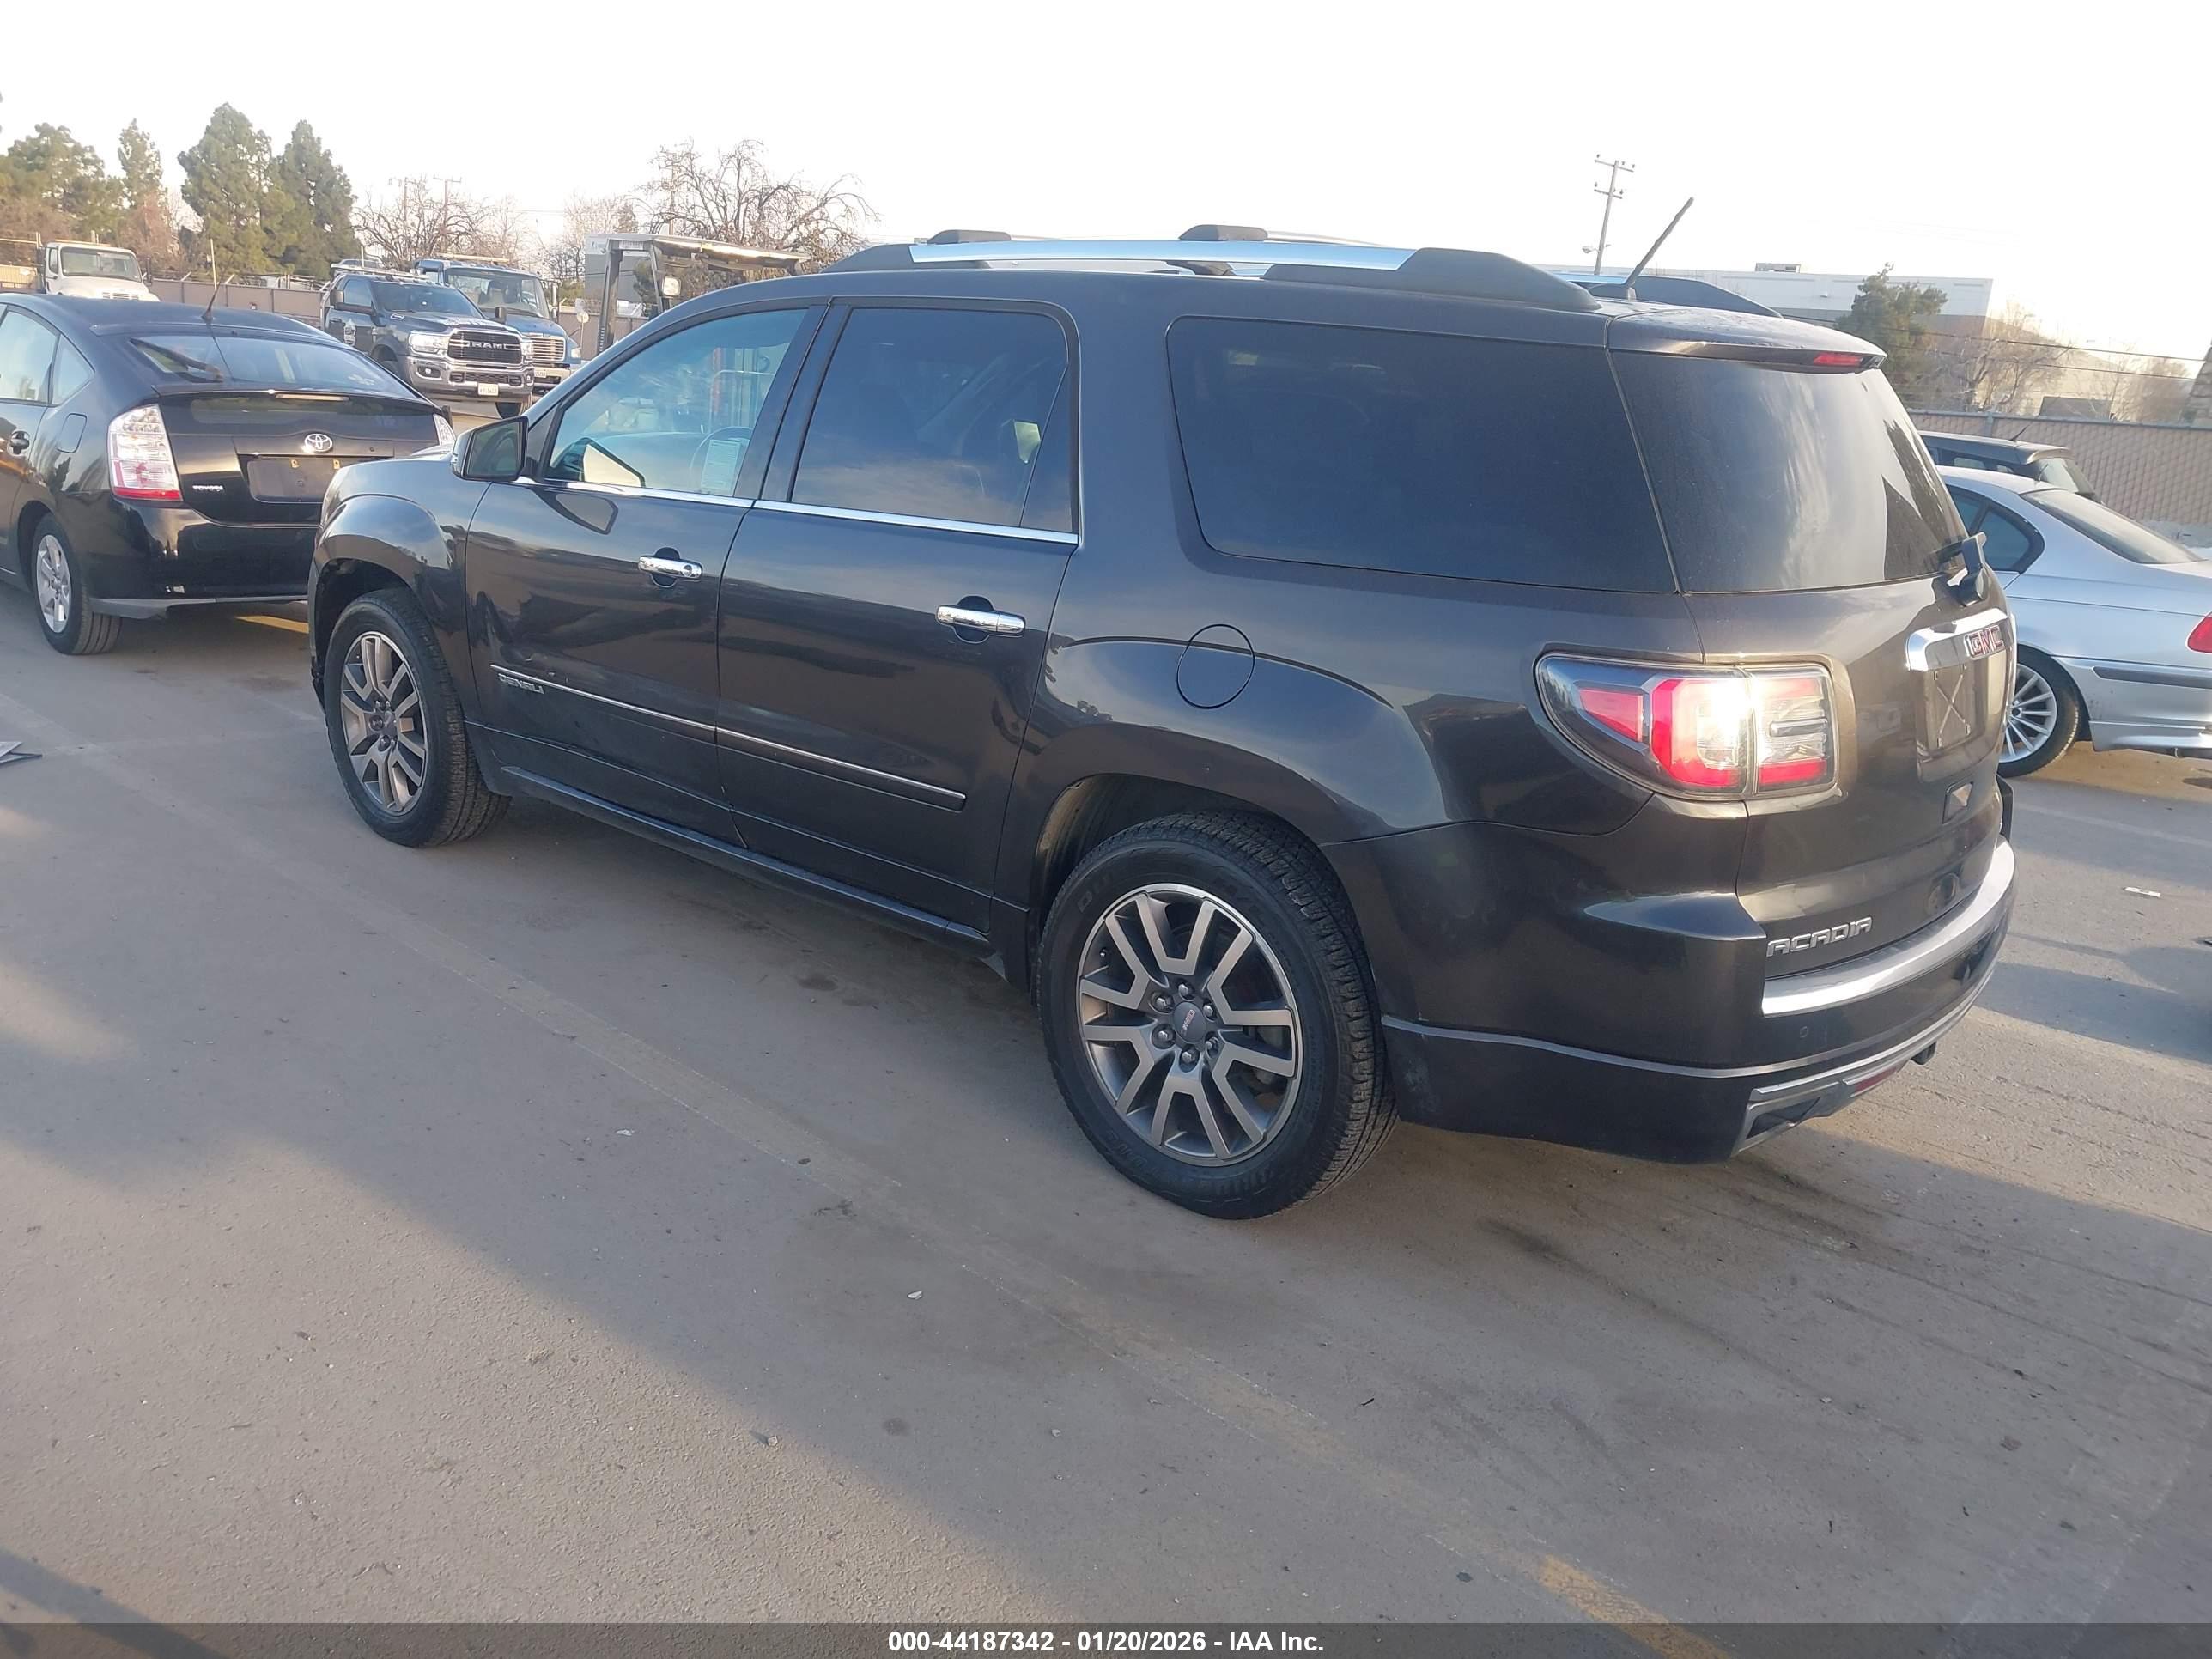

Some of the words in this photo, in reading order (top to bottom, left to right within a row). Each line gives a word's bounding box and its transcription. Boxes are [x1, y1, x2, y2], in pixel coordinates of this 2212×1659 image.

[471, 340, 504, 350] RAM
[1965, 625, 2005, 659] GMC
[497, 672, 544, 695] DENALI
[1765, 916, 1874, 957] ACADIA
